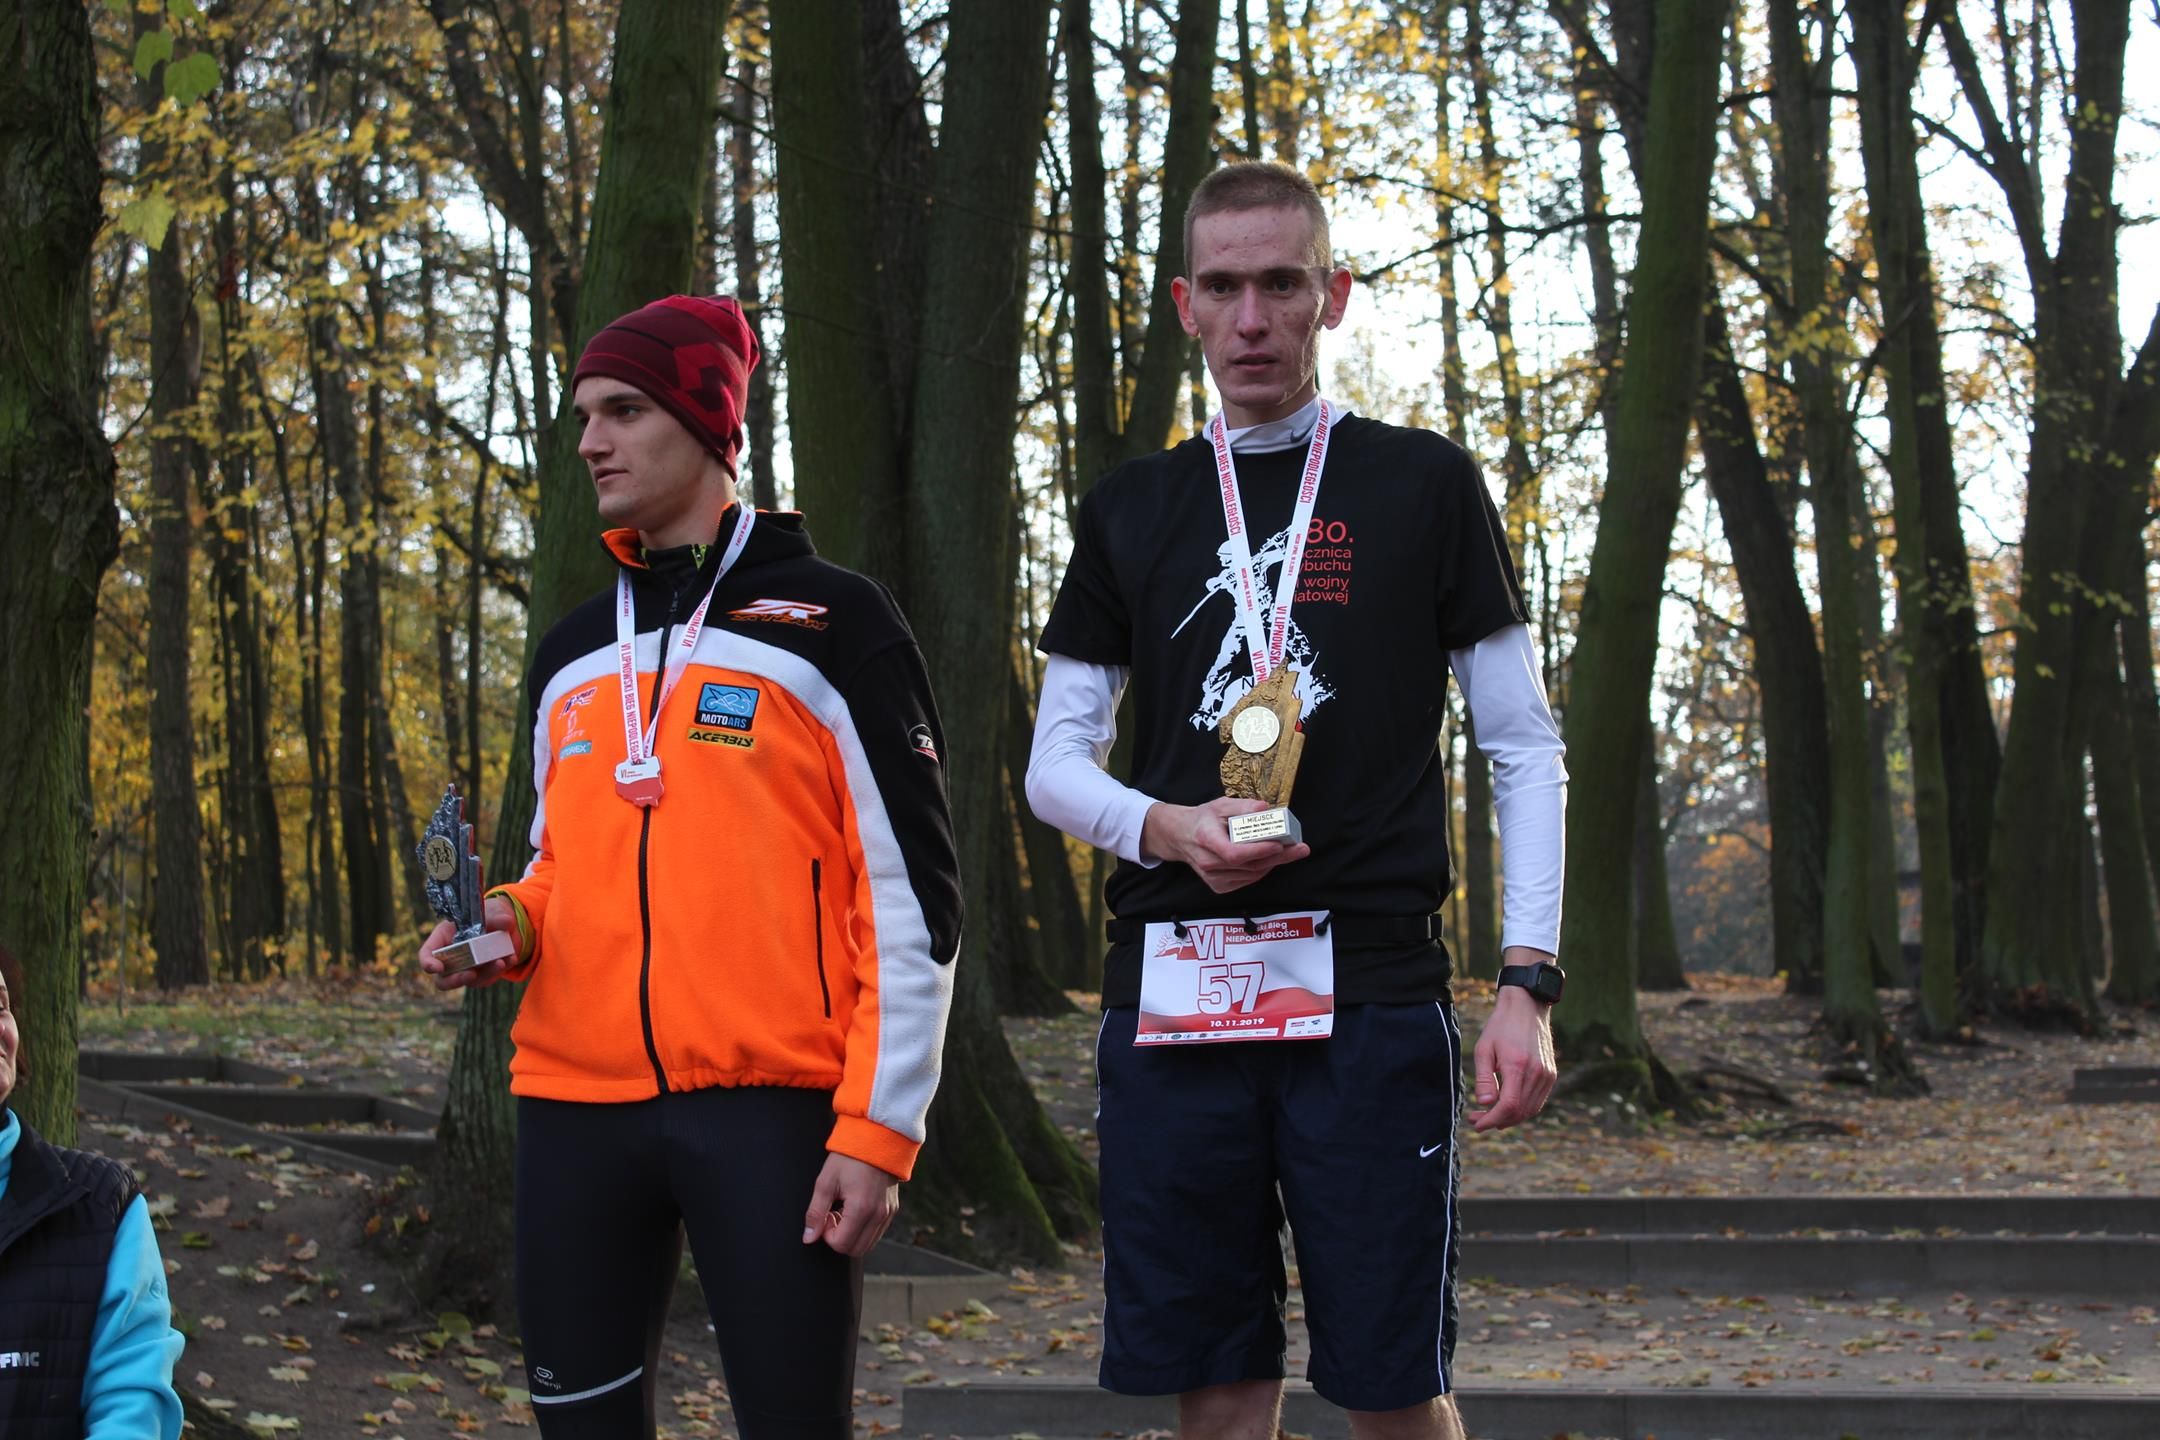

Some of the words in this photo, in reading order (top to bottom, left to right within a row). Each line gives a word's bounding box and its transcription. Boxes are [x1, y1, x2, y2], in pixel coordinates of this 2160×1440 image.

[1315, 422, 1328, 441] BIEG
[1217, 453, 1229, 472] BIEG
[1299, 441, 1325, 504] NIEPODLEGŁOŚCI
[1221, 472, 1242, 536] NIEPODLEGŁOŚCI
[1304, 546, 1352, 559] cznica
[1303, 575, 1350, 592] wojny
[1276, 606, 1288, 615] VI
[620, 642, 632, 652] VI
[681, 639, 694, 648] VI
[1270, 616, 1285, 666] LIPNOWSKI
[1252, 650, 1264, 661] VI
[622, 652, 634, 692] LIPNOWSKI
[624, 693, 636, 711] BIEG
[700, 712, 748, 729] MOTOARS
[1247, 812, 1274, 824] MIEJSCE
[1225, 922, 1267, 934] Lipnski
[1267, 921, 1288, 930] Bieg
[1187, 924, 1225, 960] VI
[1225, 929, 1300, 944] NIEPODLEGŁOŚCI
[1198, 961, 1265, 1015] 57
[1209, 1017, 1265, 1028] 10.11.2019
